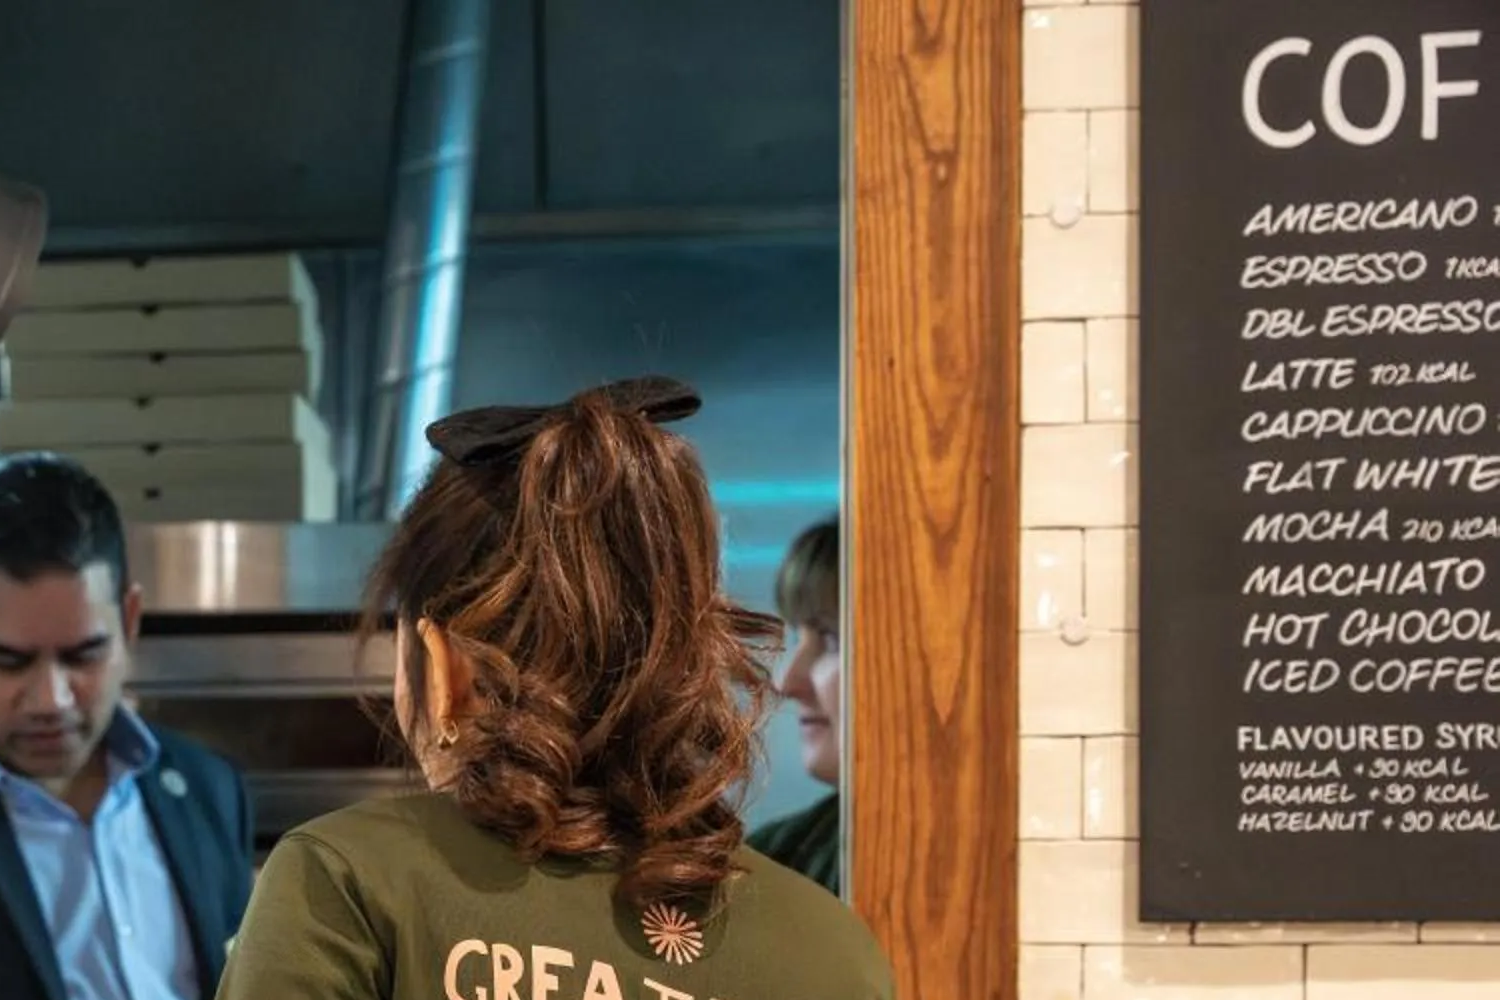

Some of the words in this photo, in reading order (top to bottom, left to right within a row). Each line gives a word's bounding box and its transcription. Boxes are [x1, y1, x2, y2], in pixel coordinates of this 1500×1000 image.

[1241, 30, 1482, 149] COF
[1243, 195, 1479, 237] AMERICANO
[1240, 250, 1428, 289] ESPRESSO
[1240, 308, 1316, 340] DBL
[1241, 358, 1357, 392] LATTE
[1241, 403, 1487, 442] CAPPUCCINO
[1243, 458, 1346, 494] FLAT
[1353, 454, 1500, 493] WHITE
[1242, 507, 1390, 544] MOCHA
[1450, 516, 1500, 541] KCA
[1242, 557, 1486, 596] MACCHIATO
[1243, 612, 1329, 650] HOT
[1338, 607, 1500, 648] CHOCOL
[1243, 658, 1340, 694] ICED
[1237, 725, 1425, 752] FLAVOURED
[1435, 722, 1500, 750] SYR
[1238, 758, 1341, 780] VANILLA
[1240, 782, 1357, 805] CARAMEL
[1424, 783, 1489, 804] KCAL
[1237, 808, 1375, 832] HAZELNUT
[1438, 810, 1500, 832] KCAL
